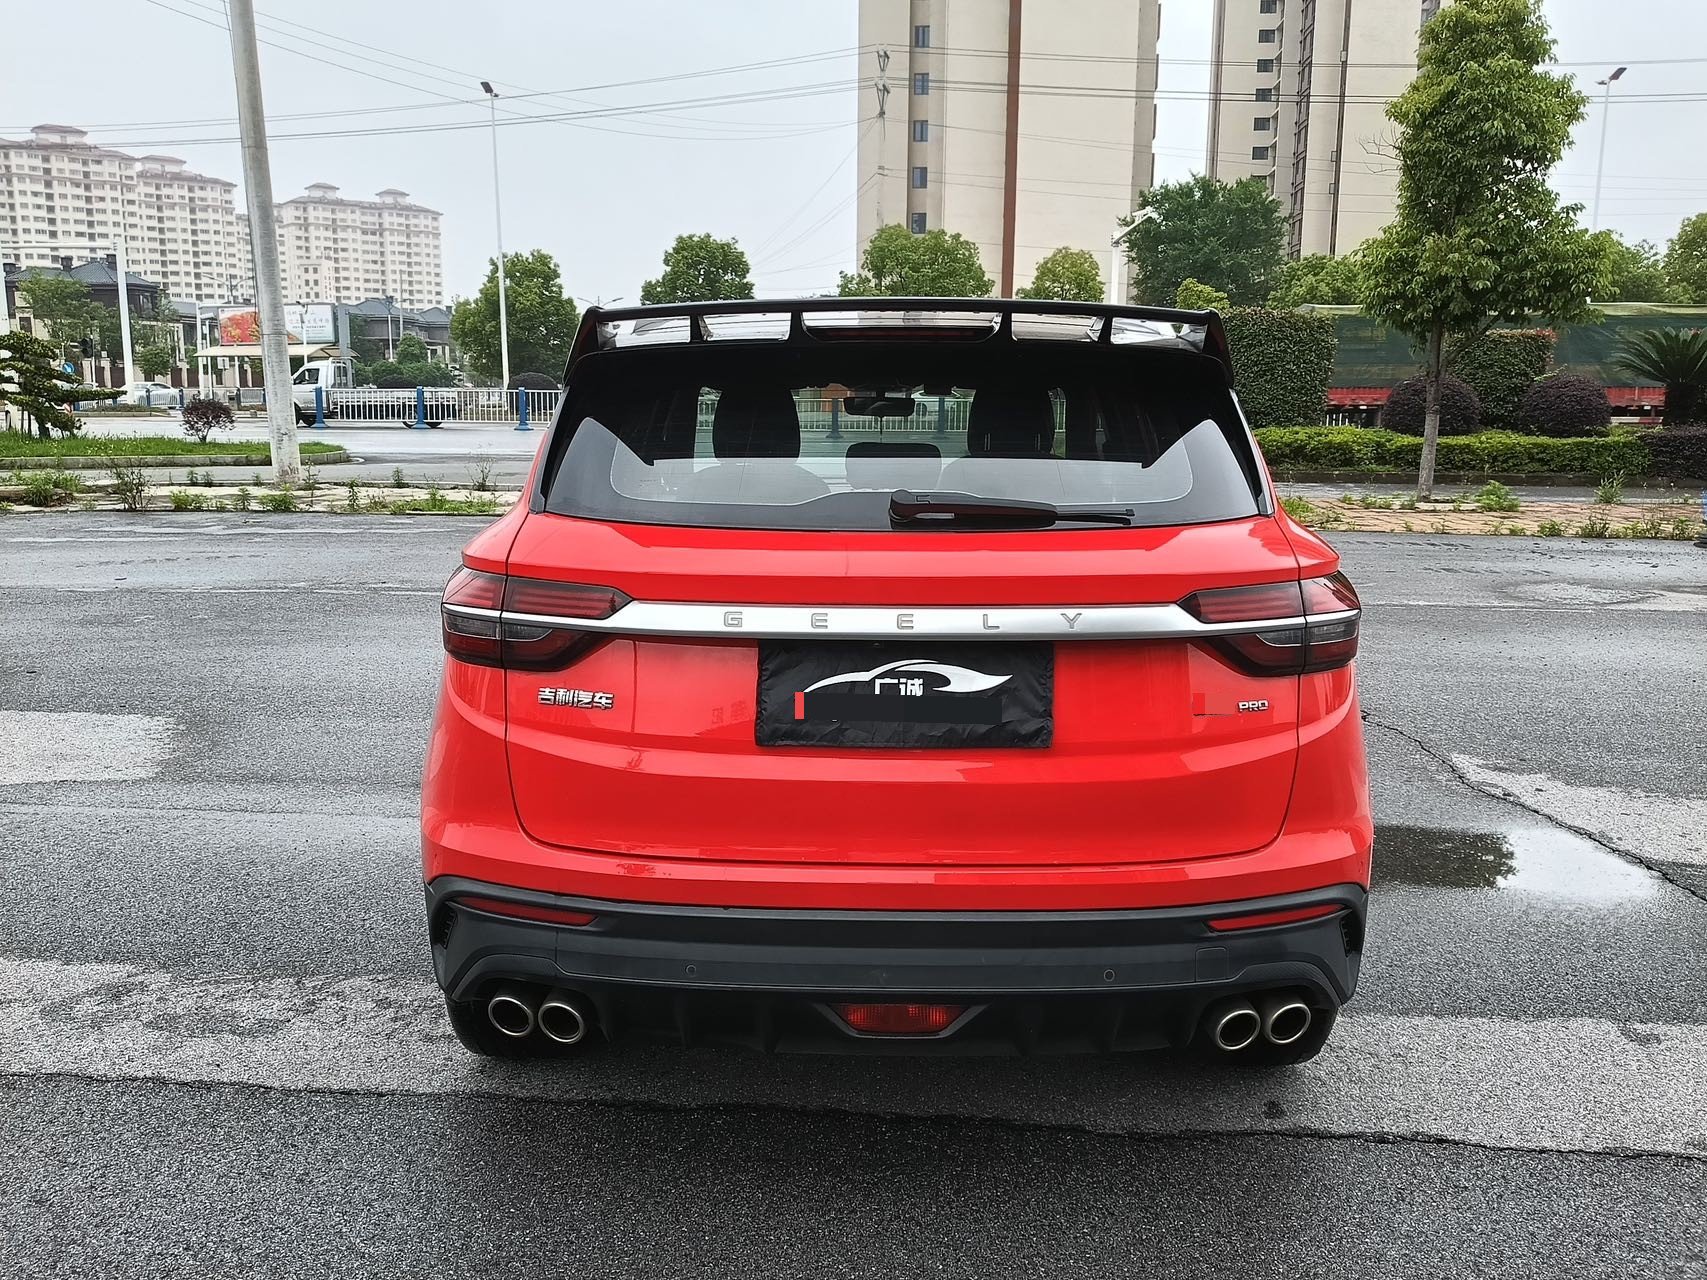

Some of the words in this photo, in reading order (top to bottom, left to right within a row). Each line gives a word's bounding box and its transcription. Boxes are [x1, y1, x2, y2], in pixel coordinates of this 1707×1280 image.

[723, 610, 1083, 630] GEELY
[538, 687, 614, 709] 吉利汽车
[1238, 699, 1269, 712] PRO
